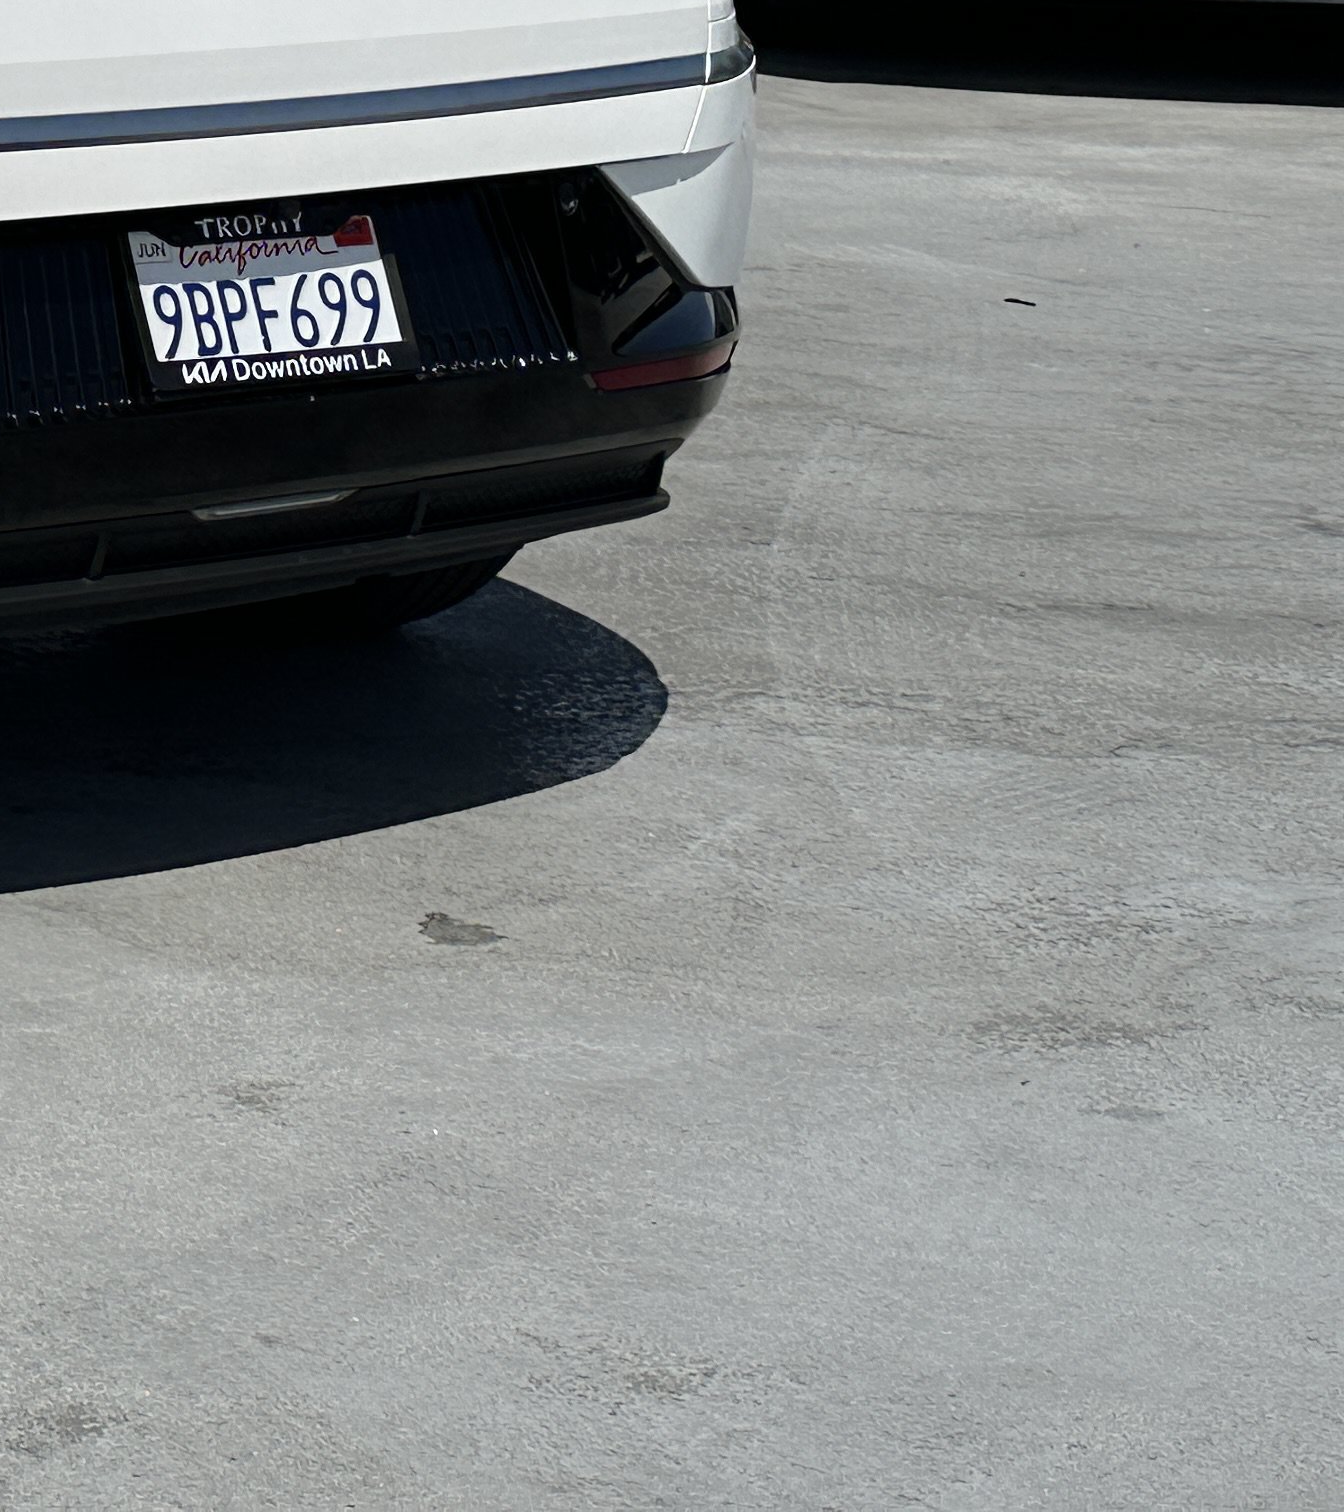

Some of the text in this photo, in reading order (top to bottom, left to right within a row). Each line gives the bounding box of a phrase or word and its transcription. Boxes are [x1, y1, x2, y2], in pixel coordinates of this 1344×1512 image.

[194, 211, 302, 238] TROPHY
[137, 242, 167, 258] JUN
[178, 235, 339, 275] California
[152, 268, 381, 359] 9BPF699
[182, 348, 391, 384] KIA Downtown LA
